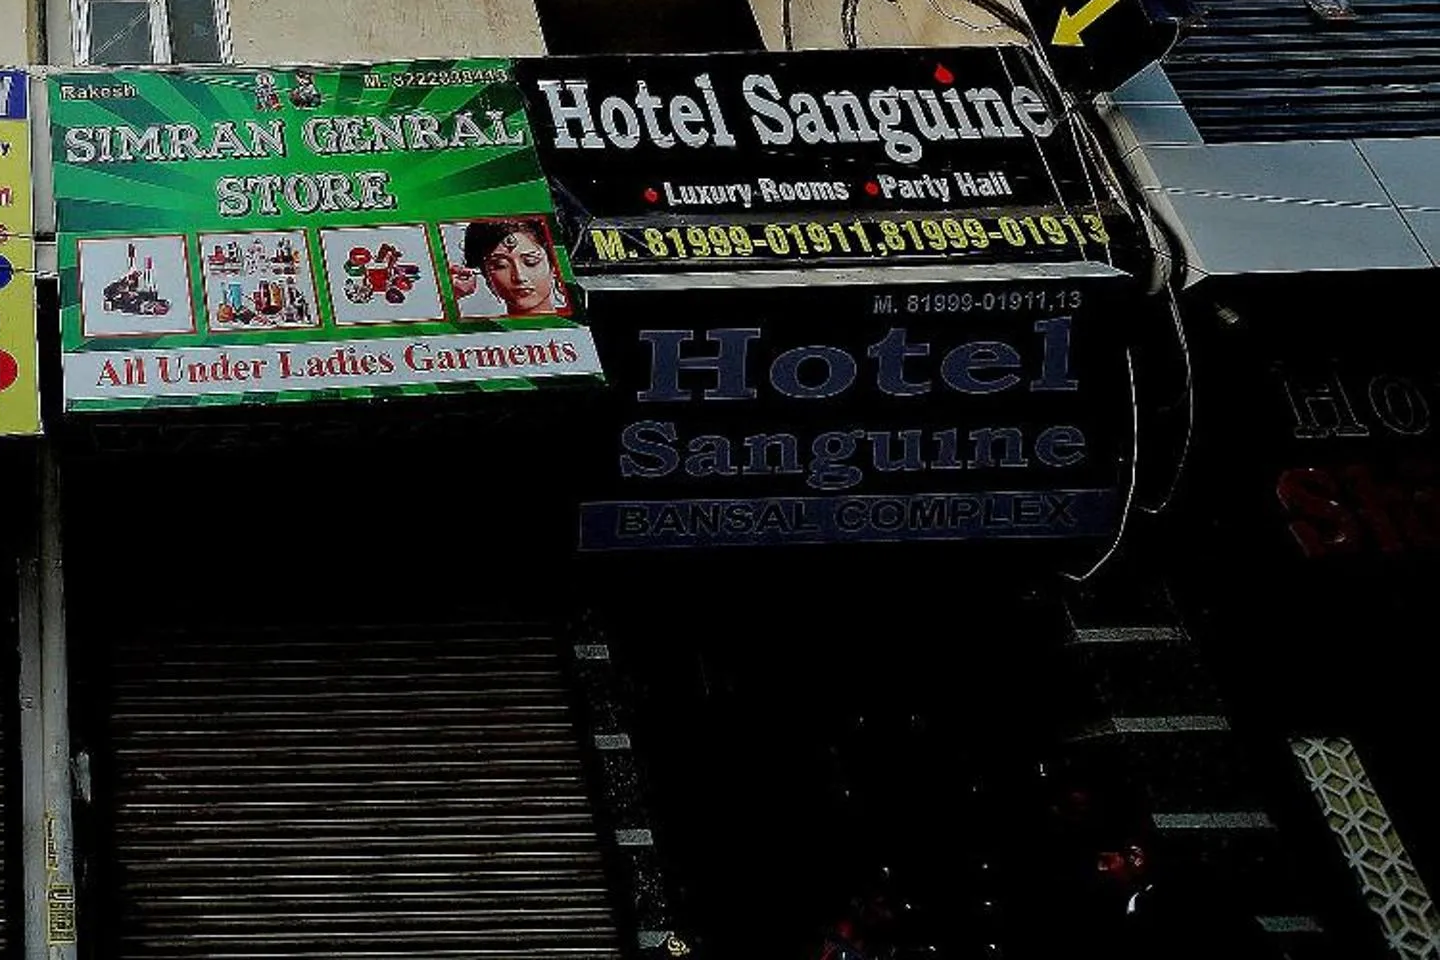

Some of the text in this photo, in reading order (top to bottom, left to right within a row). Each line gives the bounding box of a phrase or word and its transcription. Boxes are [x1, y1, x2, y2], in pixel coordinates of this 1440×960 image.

[61, 84, 138, 100] Rakesh
[537, 64, 1060, 161] Hotel Sanguine
[65, 110, 526, 163] SIMRAN GENRAL
[215, 171, 398, 218] STORE
[664, 170, 1013, 206] Luxury Rooms Party Hall
[591, 214, 1110, 260] M. 81999-01911,81999-01913
[872, 290, 1083, 315] M. 81999-01911,13
[96, 338, 578, 386] All Under Ladies Garments
[637, 315, 1080, 403] Hotel
[620, 420, 1088, 490] Sanguine
[616, 492, 1079, 538] BANSAL COMPLEX
